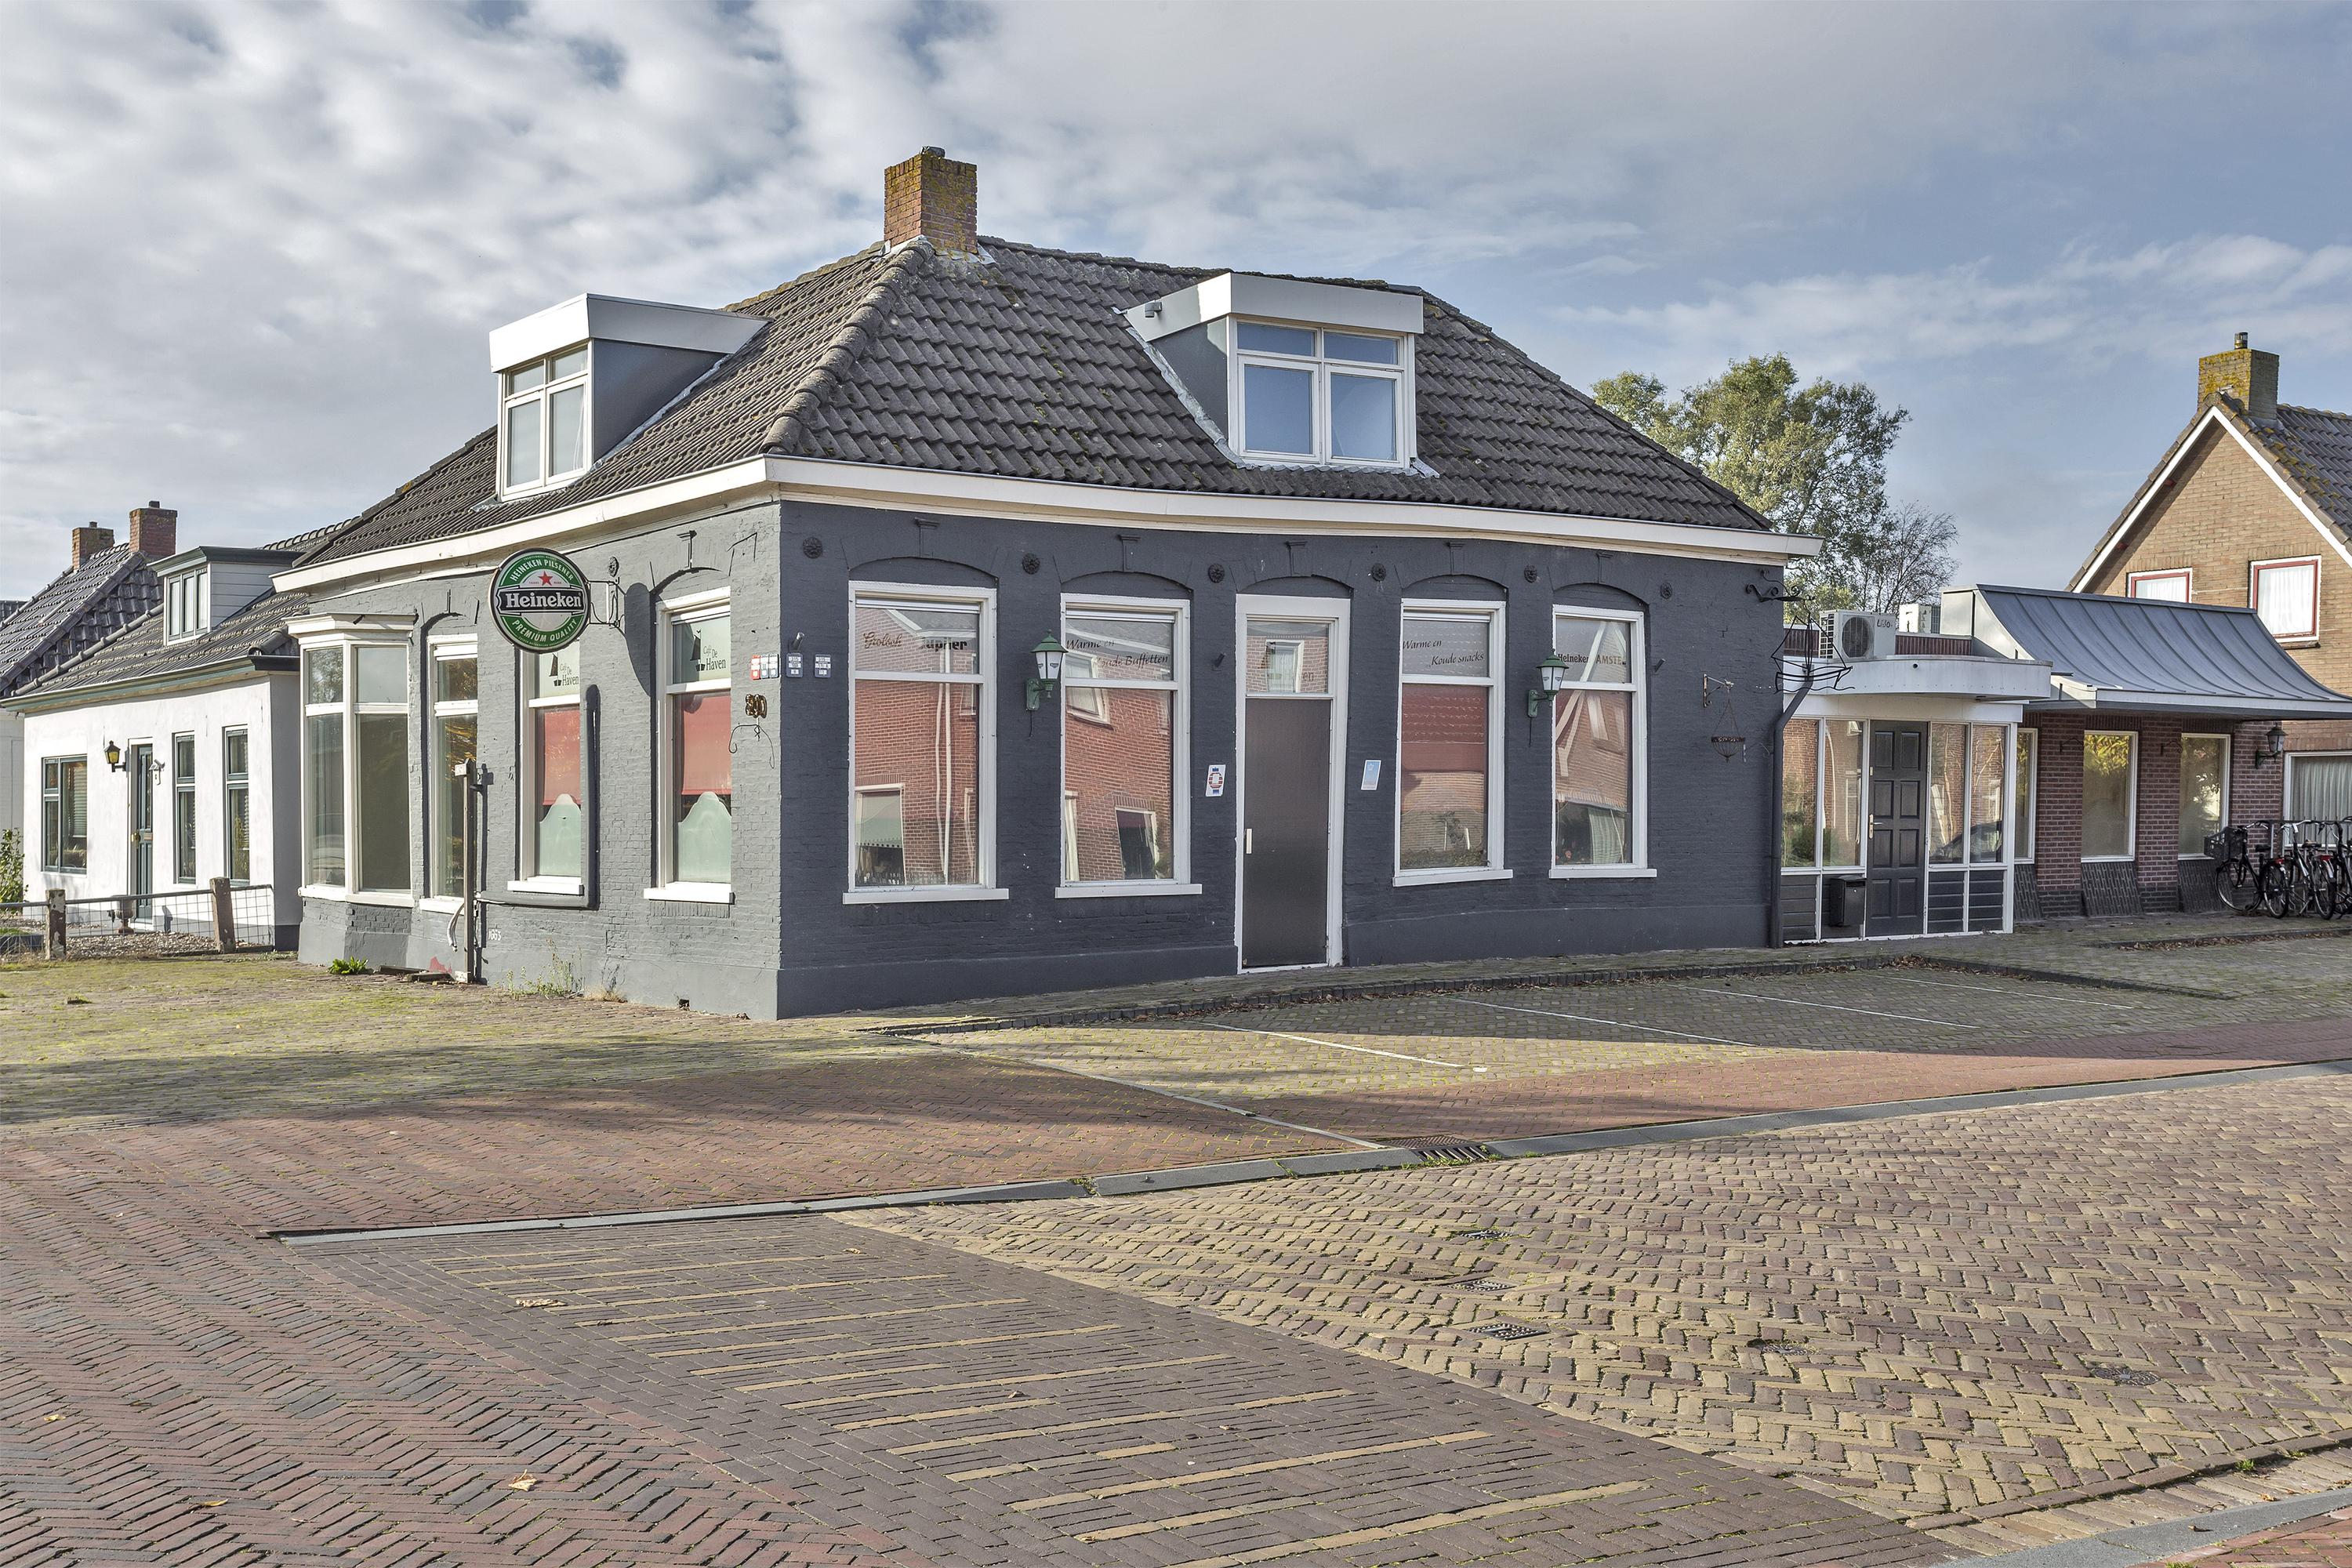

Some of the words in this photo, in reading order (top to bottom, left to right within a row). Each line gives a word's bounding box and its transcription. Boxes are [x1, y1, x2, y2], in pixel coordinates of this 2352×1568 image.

[510, 559, 543, 581] HEINEKEN
[543, 559, 574, 580] PILSENER
[505, 592, 582, 608] Heineken
[512, 619, 547, 642] PREMIUM
[550, 619, 577, 641] QUALITY
[1403, 639, 1431, 649] Warme
[706, 658, 726, 671] Haven
[1124, 652, 1168, 668] Buffetten
[1431, 652, 1456, 666] Koude
[1457, 651, 1484, 663] snacks
[562, 674, 579, 686] Haven
